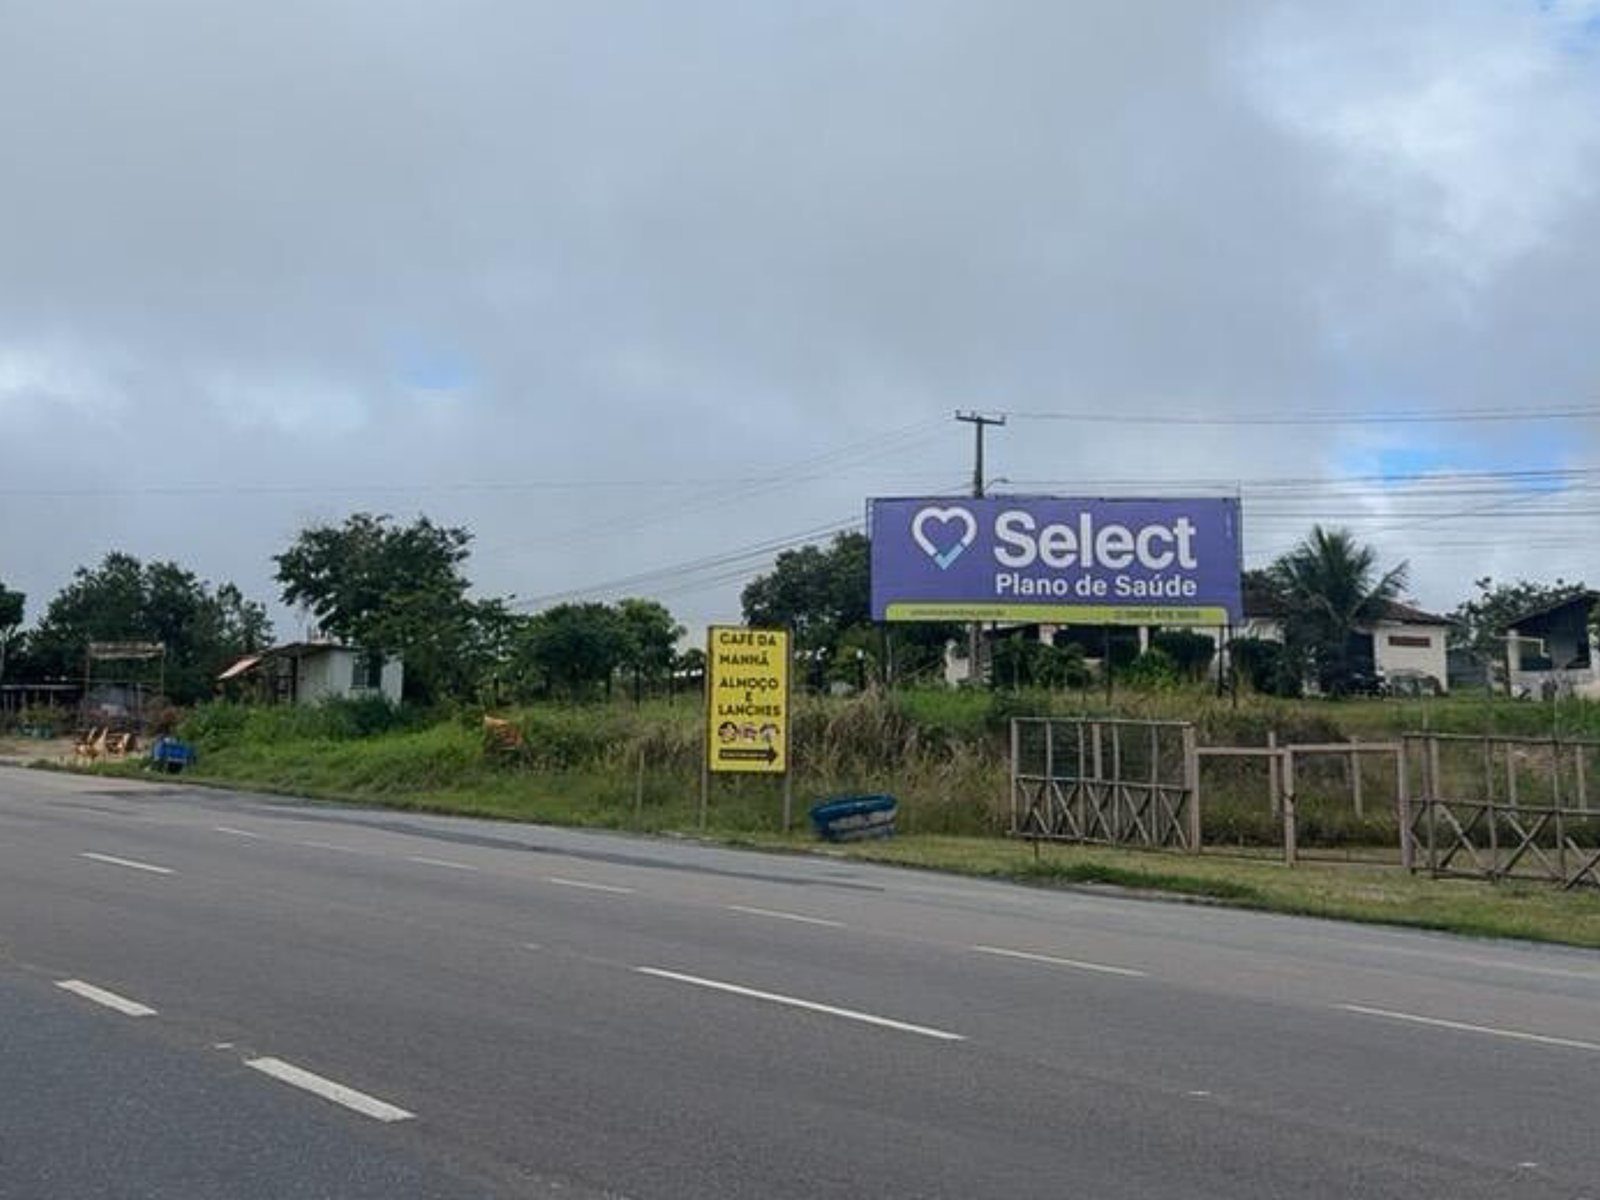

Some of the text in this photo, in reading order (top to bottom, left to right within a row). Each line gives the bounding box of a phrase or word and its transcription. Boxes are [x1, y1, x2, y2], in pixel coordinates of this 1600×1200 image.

[994, 510, 1197, 569] Select
[995, 573, 1197, 596] Plano de Saúde
[757, 634, 777, 646] DA
[719, 677, 779, 692] ALMOÇO
[745, 692, 753, 702] E
